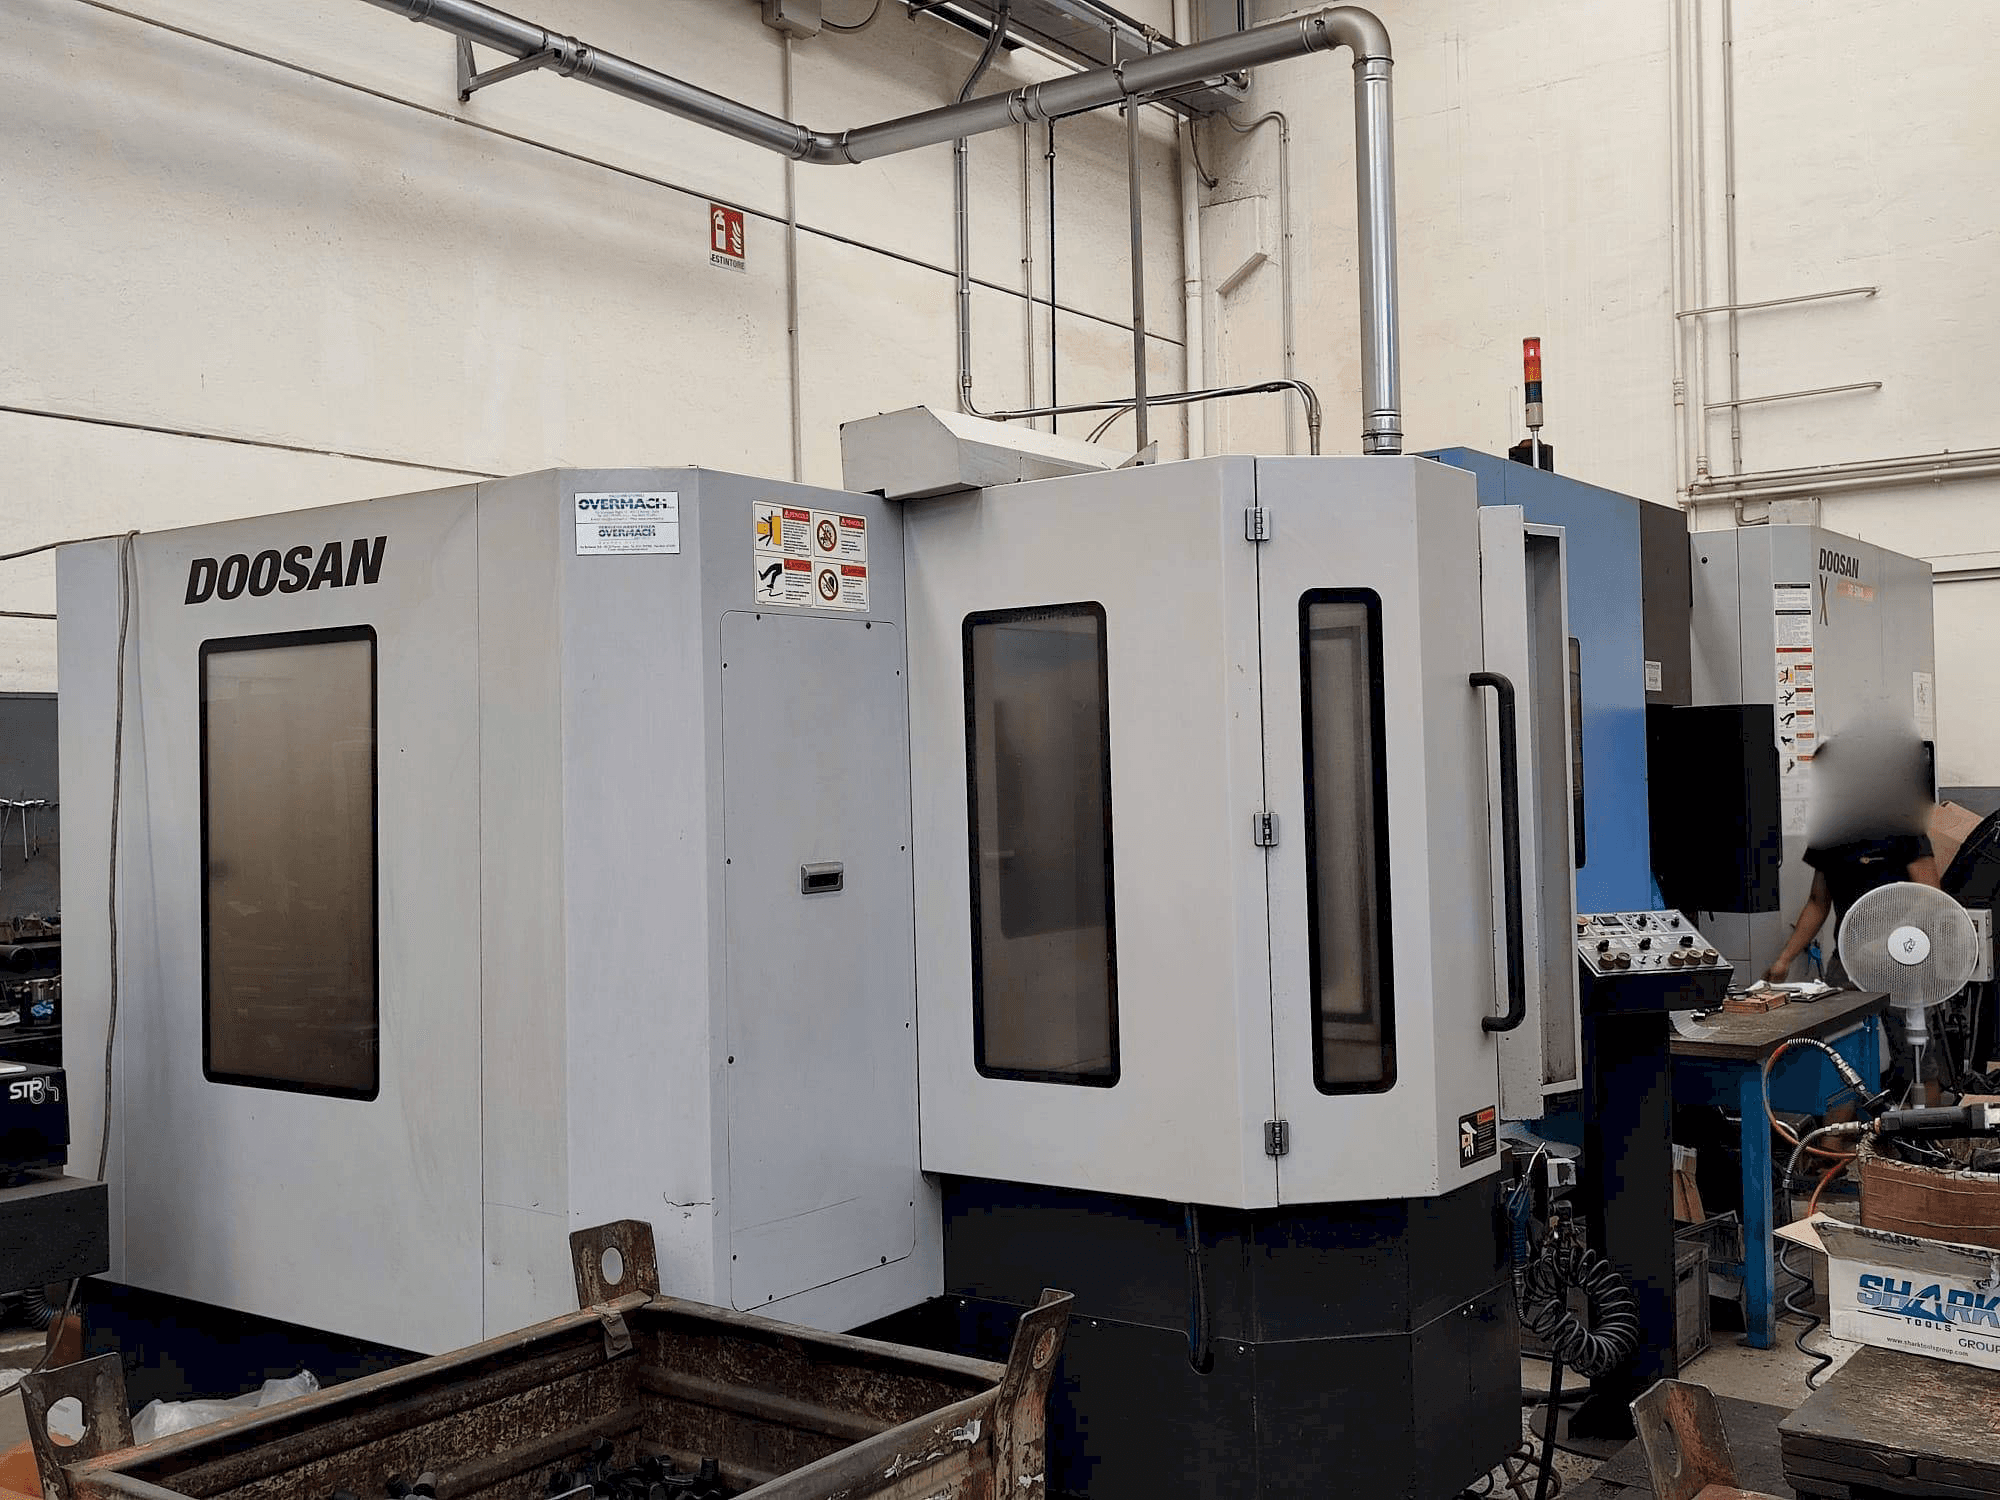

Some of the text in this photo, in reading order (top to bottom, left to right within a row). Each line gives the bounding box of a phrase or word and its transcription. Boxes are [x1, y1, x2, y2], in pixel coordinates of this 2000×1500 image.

[578, 497, 667, 510] OVERMACH
[598, 528, 656, 537] OVERMACH
[184, 535, 387, 605] DOOSAN
[1819, 548, 1859, 579] DOOSAN
[1857, 1273, 2000, 1329] SHARK
[1905, 1317, 1952, 1332] TOOLS
[1886, 1336, 1969, 1357] www.sharktoolsgroup.com
[1958, 1338, 2000, 1354] GROUP
